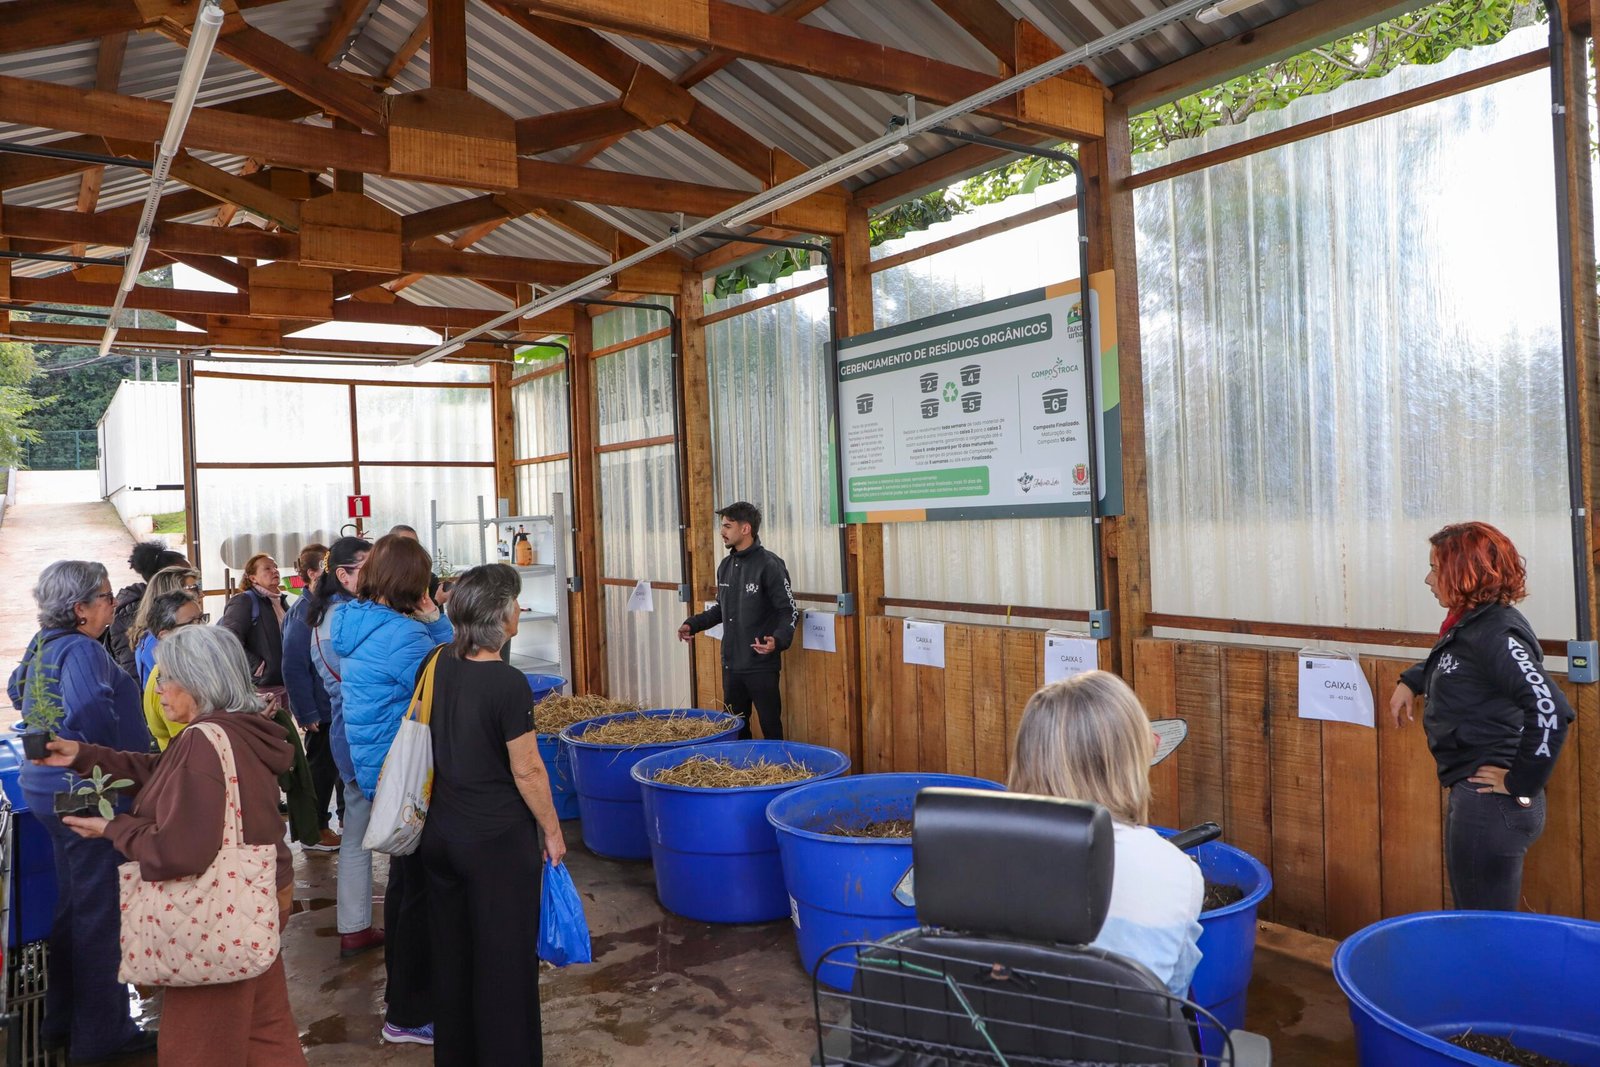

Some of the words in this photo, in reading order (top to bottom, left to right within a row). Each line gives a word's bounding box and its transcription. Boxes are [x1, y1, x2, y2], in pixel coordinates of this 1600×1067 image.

[840, 351, 912, 376] GERENCIAMENTO
[914, 348, 926, 360] DE
[928, 337, 980, 357] RESÍDUOS
[982, 322, 1048, 346] ORGÂNICOS
[1031, 364, 1079, 379] COMPOSTROCA
[968, 372, 974, 383] 4
[926, 380, 932, 390] 2
[863, 401, 867, 412] 1
[969, 400, 974, 410] 5
[1052, 398, 1060, 411] 6
[927, 406, 933, 416] 3
[1324, 680, 1351, 690] CAIXA
[1508, 636, 1558, 758] AGRONOMIA
